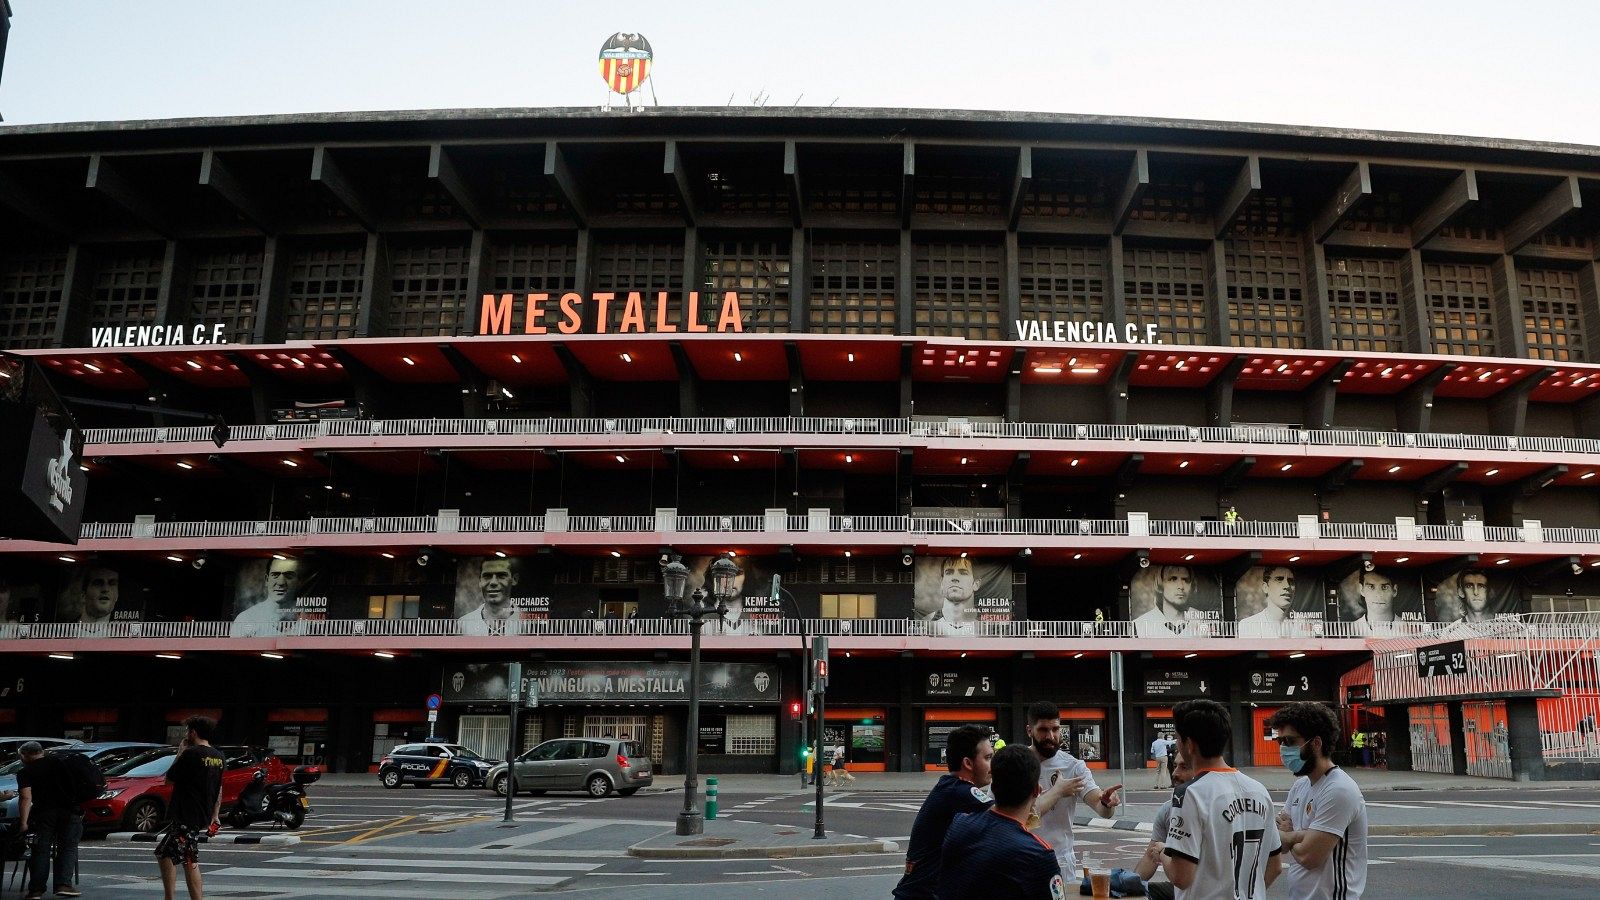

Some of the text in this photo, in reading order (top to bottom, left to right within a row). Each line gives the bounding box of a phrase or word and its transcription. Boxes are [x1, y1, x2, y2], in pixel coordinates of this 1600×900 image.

[479, 291, 743, 334] MESTALLA
[91, 323, 227, 347] VALENCIA C.F.
[1015, 319, 1163, 344] VALENCIA C.F.
[296, 597, 328, 607] MUNDO
[510, 597, 550, 606] PUCHADES
[978, 598, 1010, 607] ALBELDA
[114, 610, 140, 620] BARAJA
[1184, 610, 1220, 620] MENDIETA
[1401, 611, 1423, 621] AYALA
[1451, 653, 1465, 669] 52
[16, 677, 25, 693] 6
[604, 678, 614, 693] A
[617, 677, 685, 693] MESTALLA
[982, 677, 990, 692] 5
[1301, 676, 1309, 691] 3
[1221, 798, 1268, 824] COQUELIN
[1168, 832, 1183, 841] YRE
[1169, 827, 1192, 838] ILUN
[1229, 828, 1266, 900] 17
